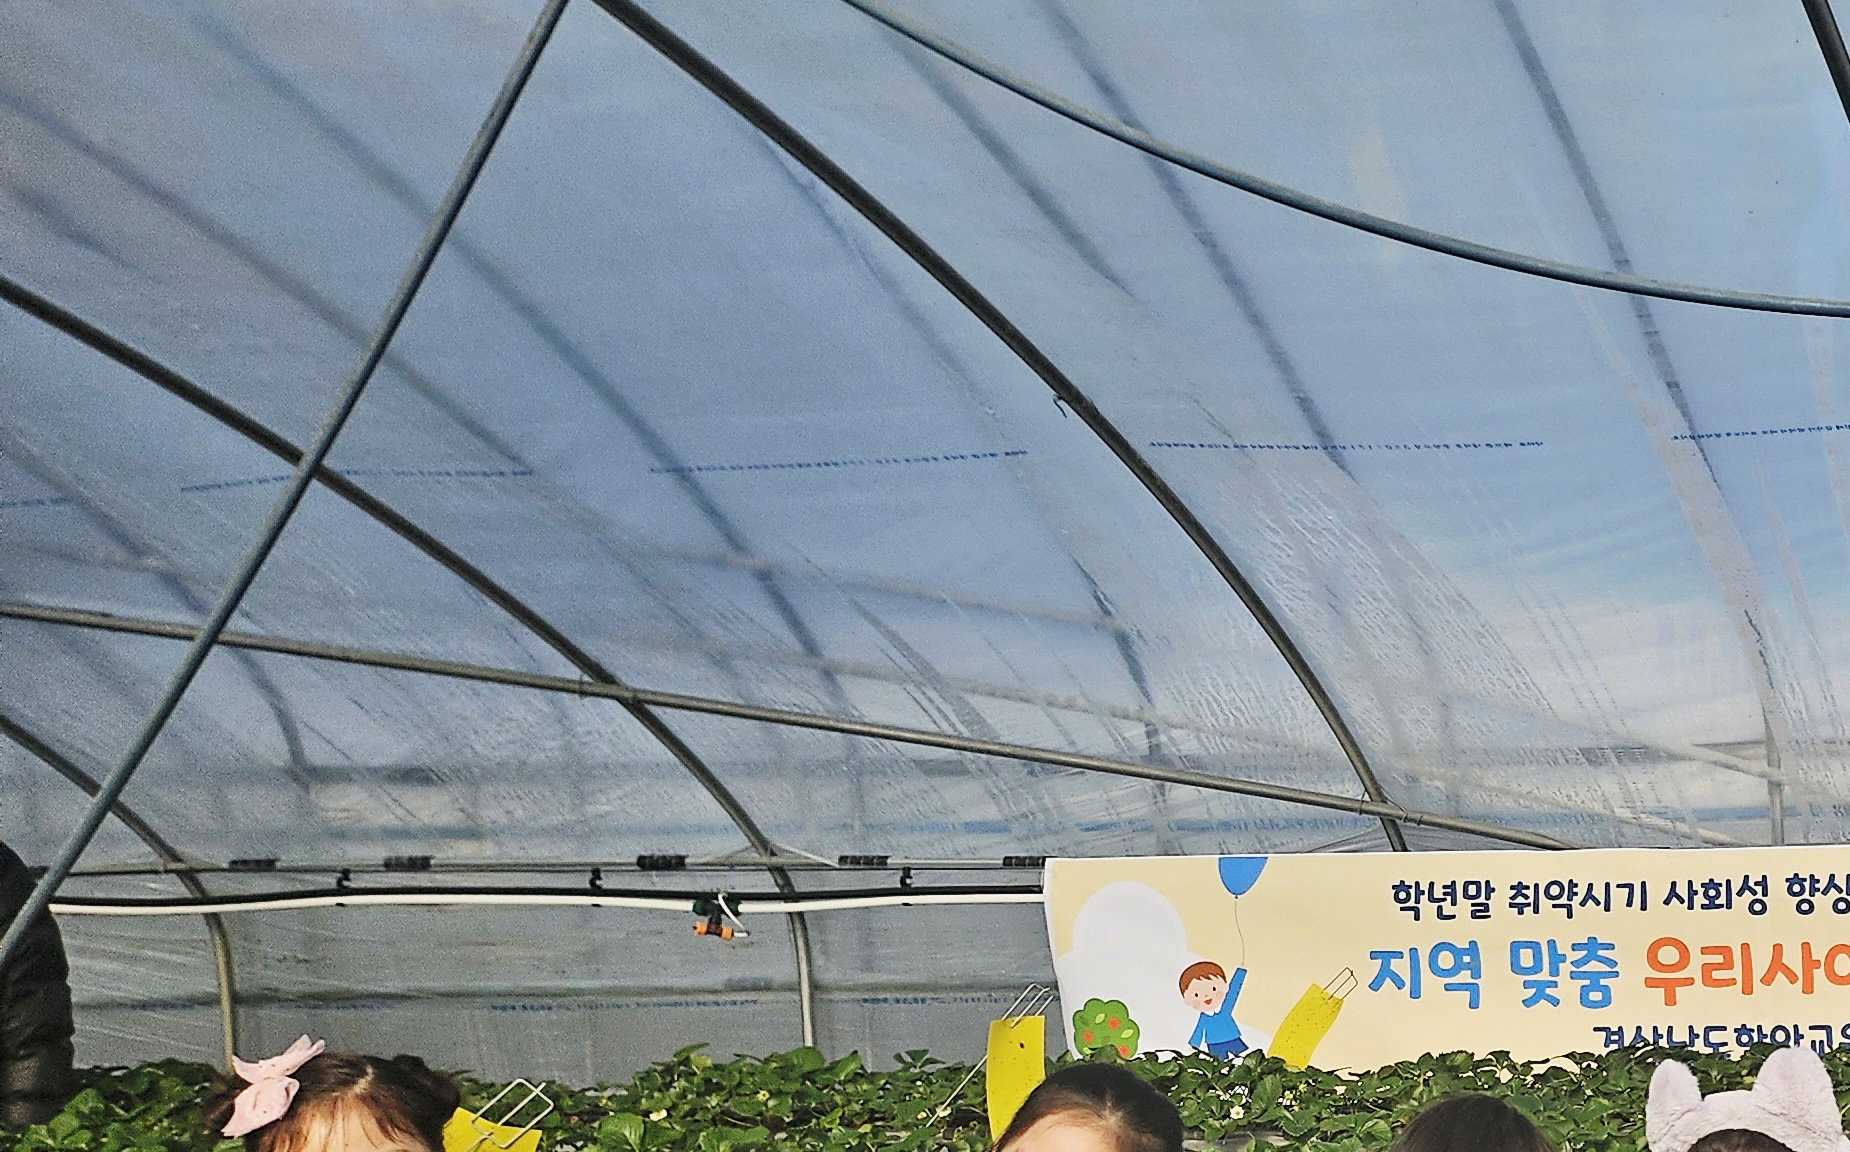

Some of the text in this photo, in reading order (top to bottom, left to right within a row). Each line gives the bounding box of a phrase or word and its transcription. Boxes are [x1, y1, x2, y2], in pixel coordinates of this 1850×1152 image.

[1391, 879, 1497, 922] 학년말
[1508, 877, 1649, 920] 취약시기
[1662, 874, 1769, 916] 사회성
[1367, 939, 1482, 1010] 지역
[1509, 936, 1620, 1010] 맞춤
